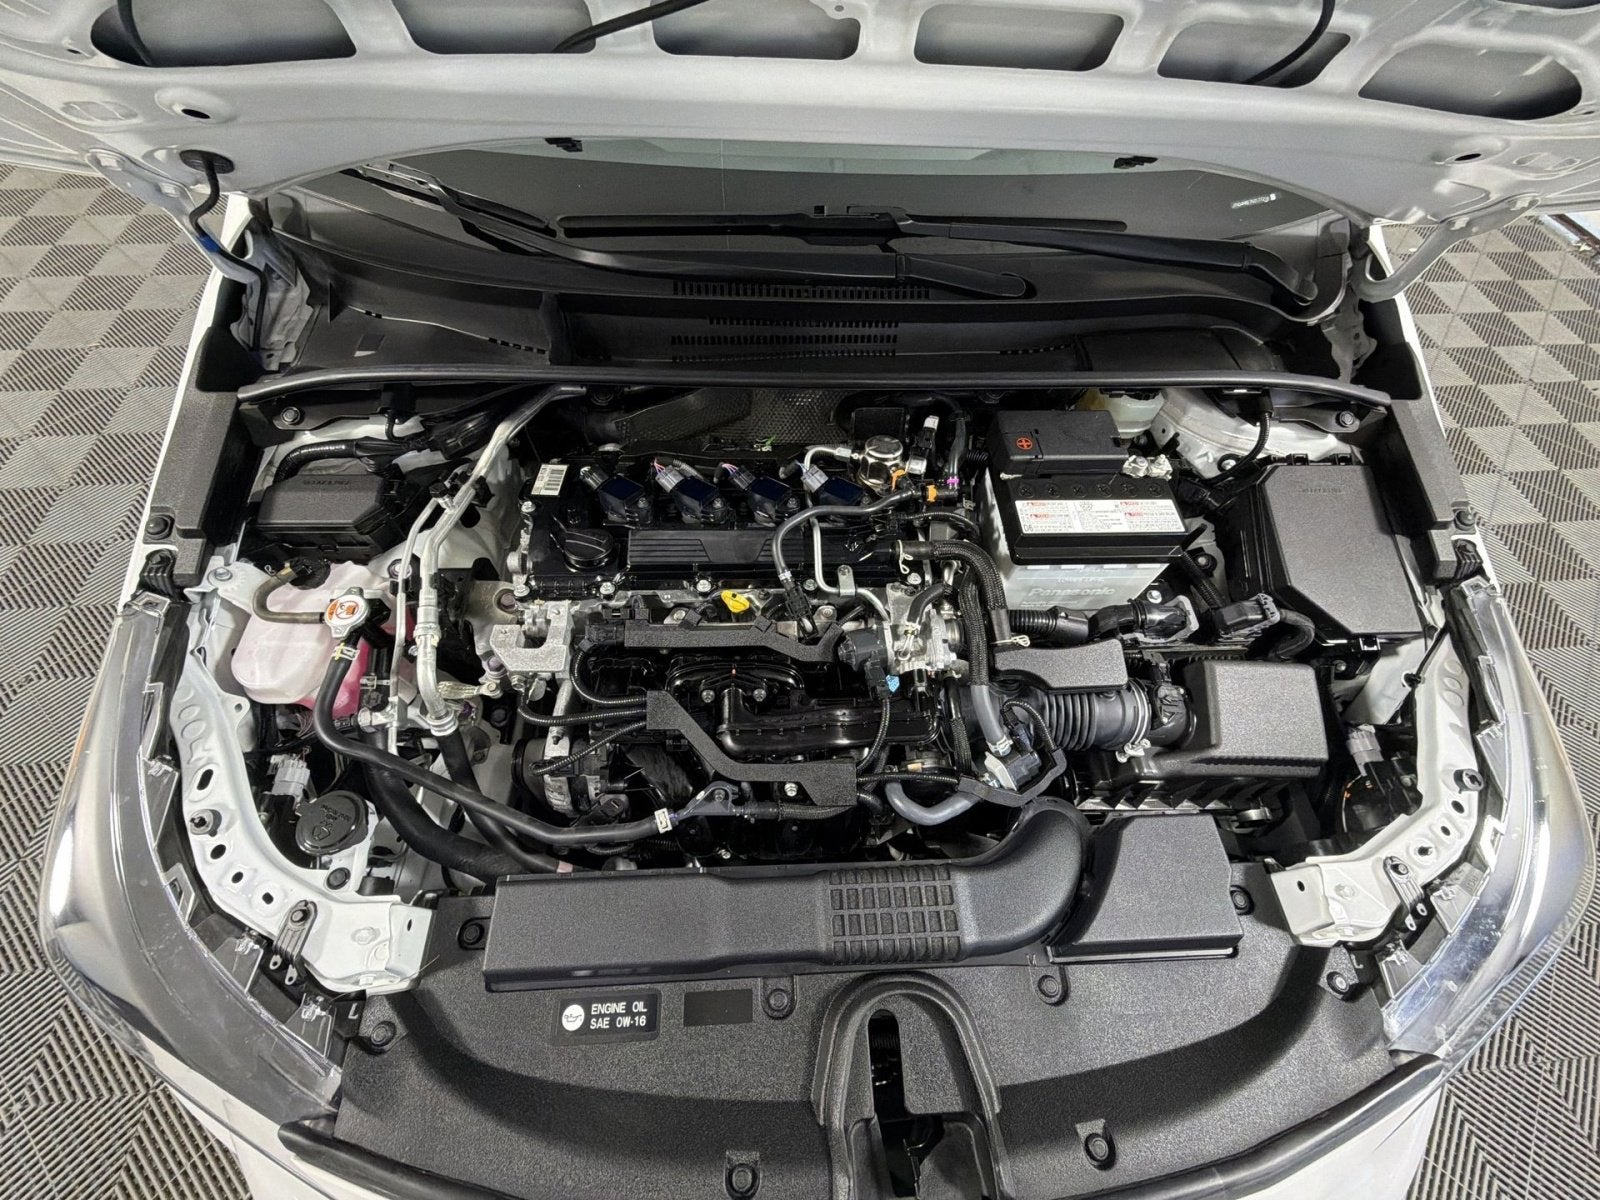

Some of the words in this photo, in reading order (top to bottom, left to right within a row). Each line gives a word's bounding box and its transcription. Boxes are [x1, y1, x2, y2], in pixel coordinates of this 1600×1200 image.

[1027, 586, 1116, 597] Panasonic
[591, 1002, 626, 1014] ENGINE
[632, 1001, 647, 1012] OIL
[590, 1017, 610, 1029] SAE
[616, 1015, 646, 1027] 0W-16
